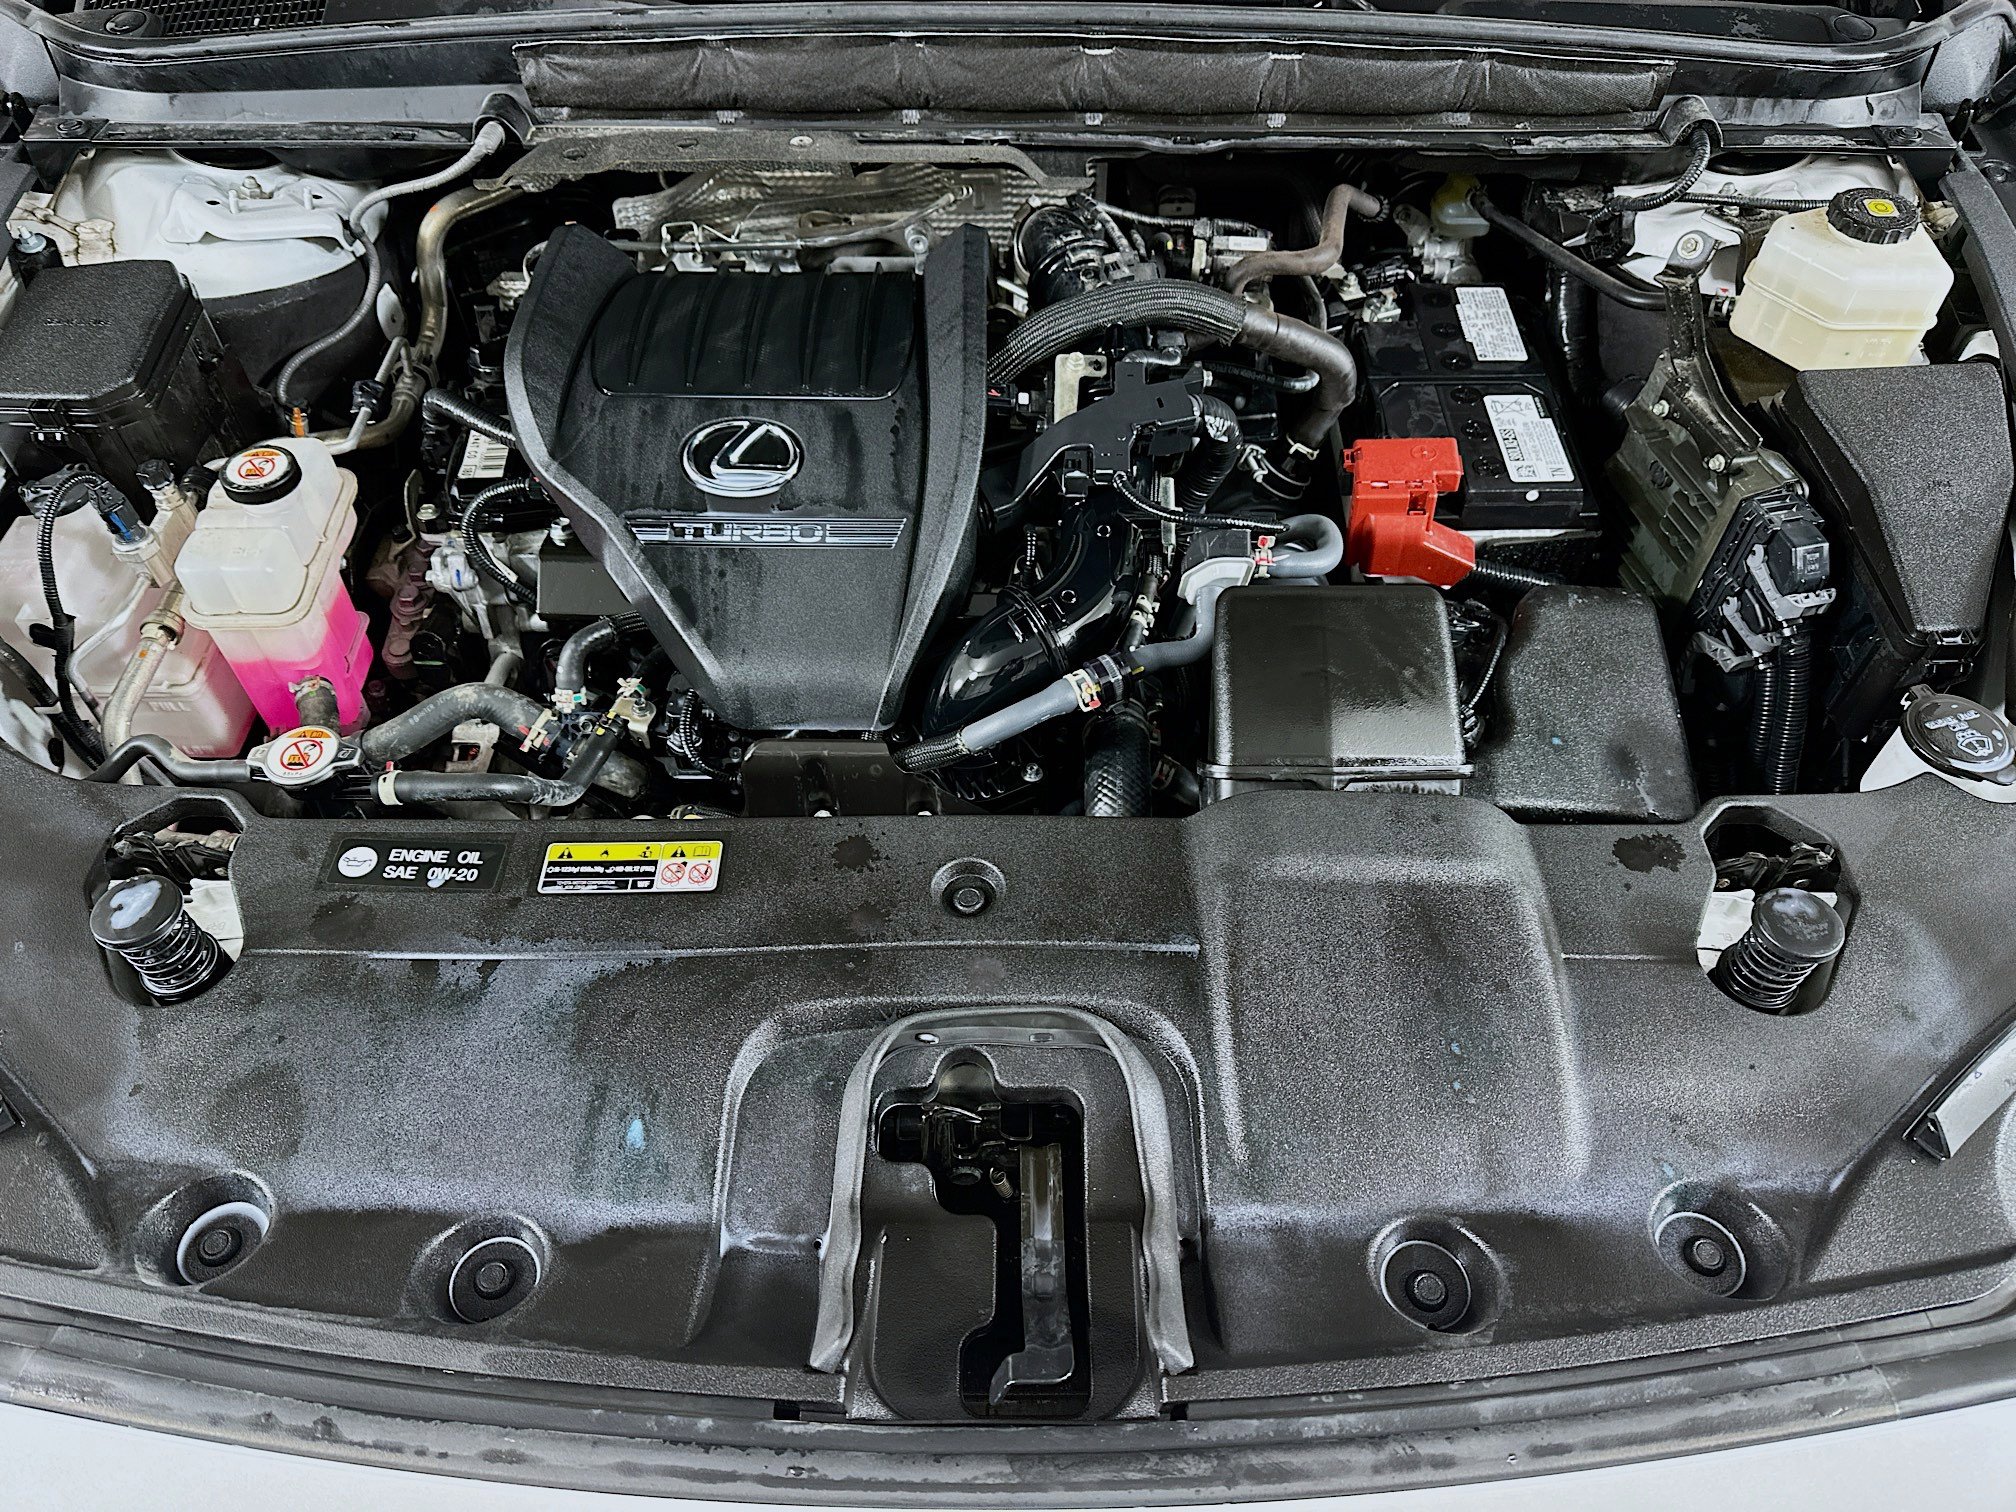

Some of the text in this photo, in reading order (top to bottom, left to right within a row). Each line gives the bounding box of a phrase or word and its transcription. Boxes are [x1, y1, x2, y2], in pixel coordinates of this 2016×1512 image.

[672, 522, 824, 543] TURBO
[388, 848, 484, 864] ENGINE OIL
[382, 865, 479, 881] SAE 0W-20
